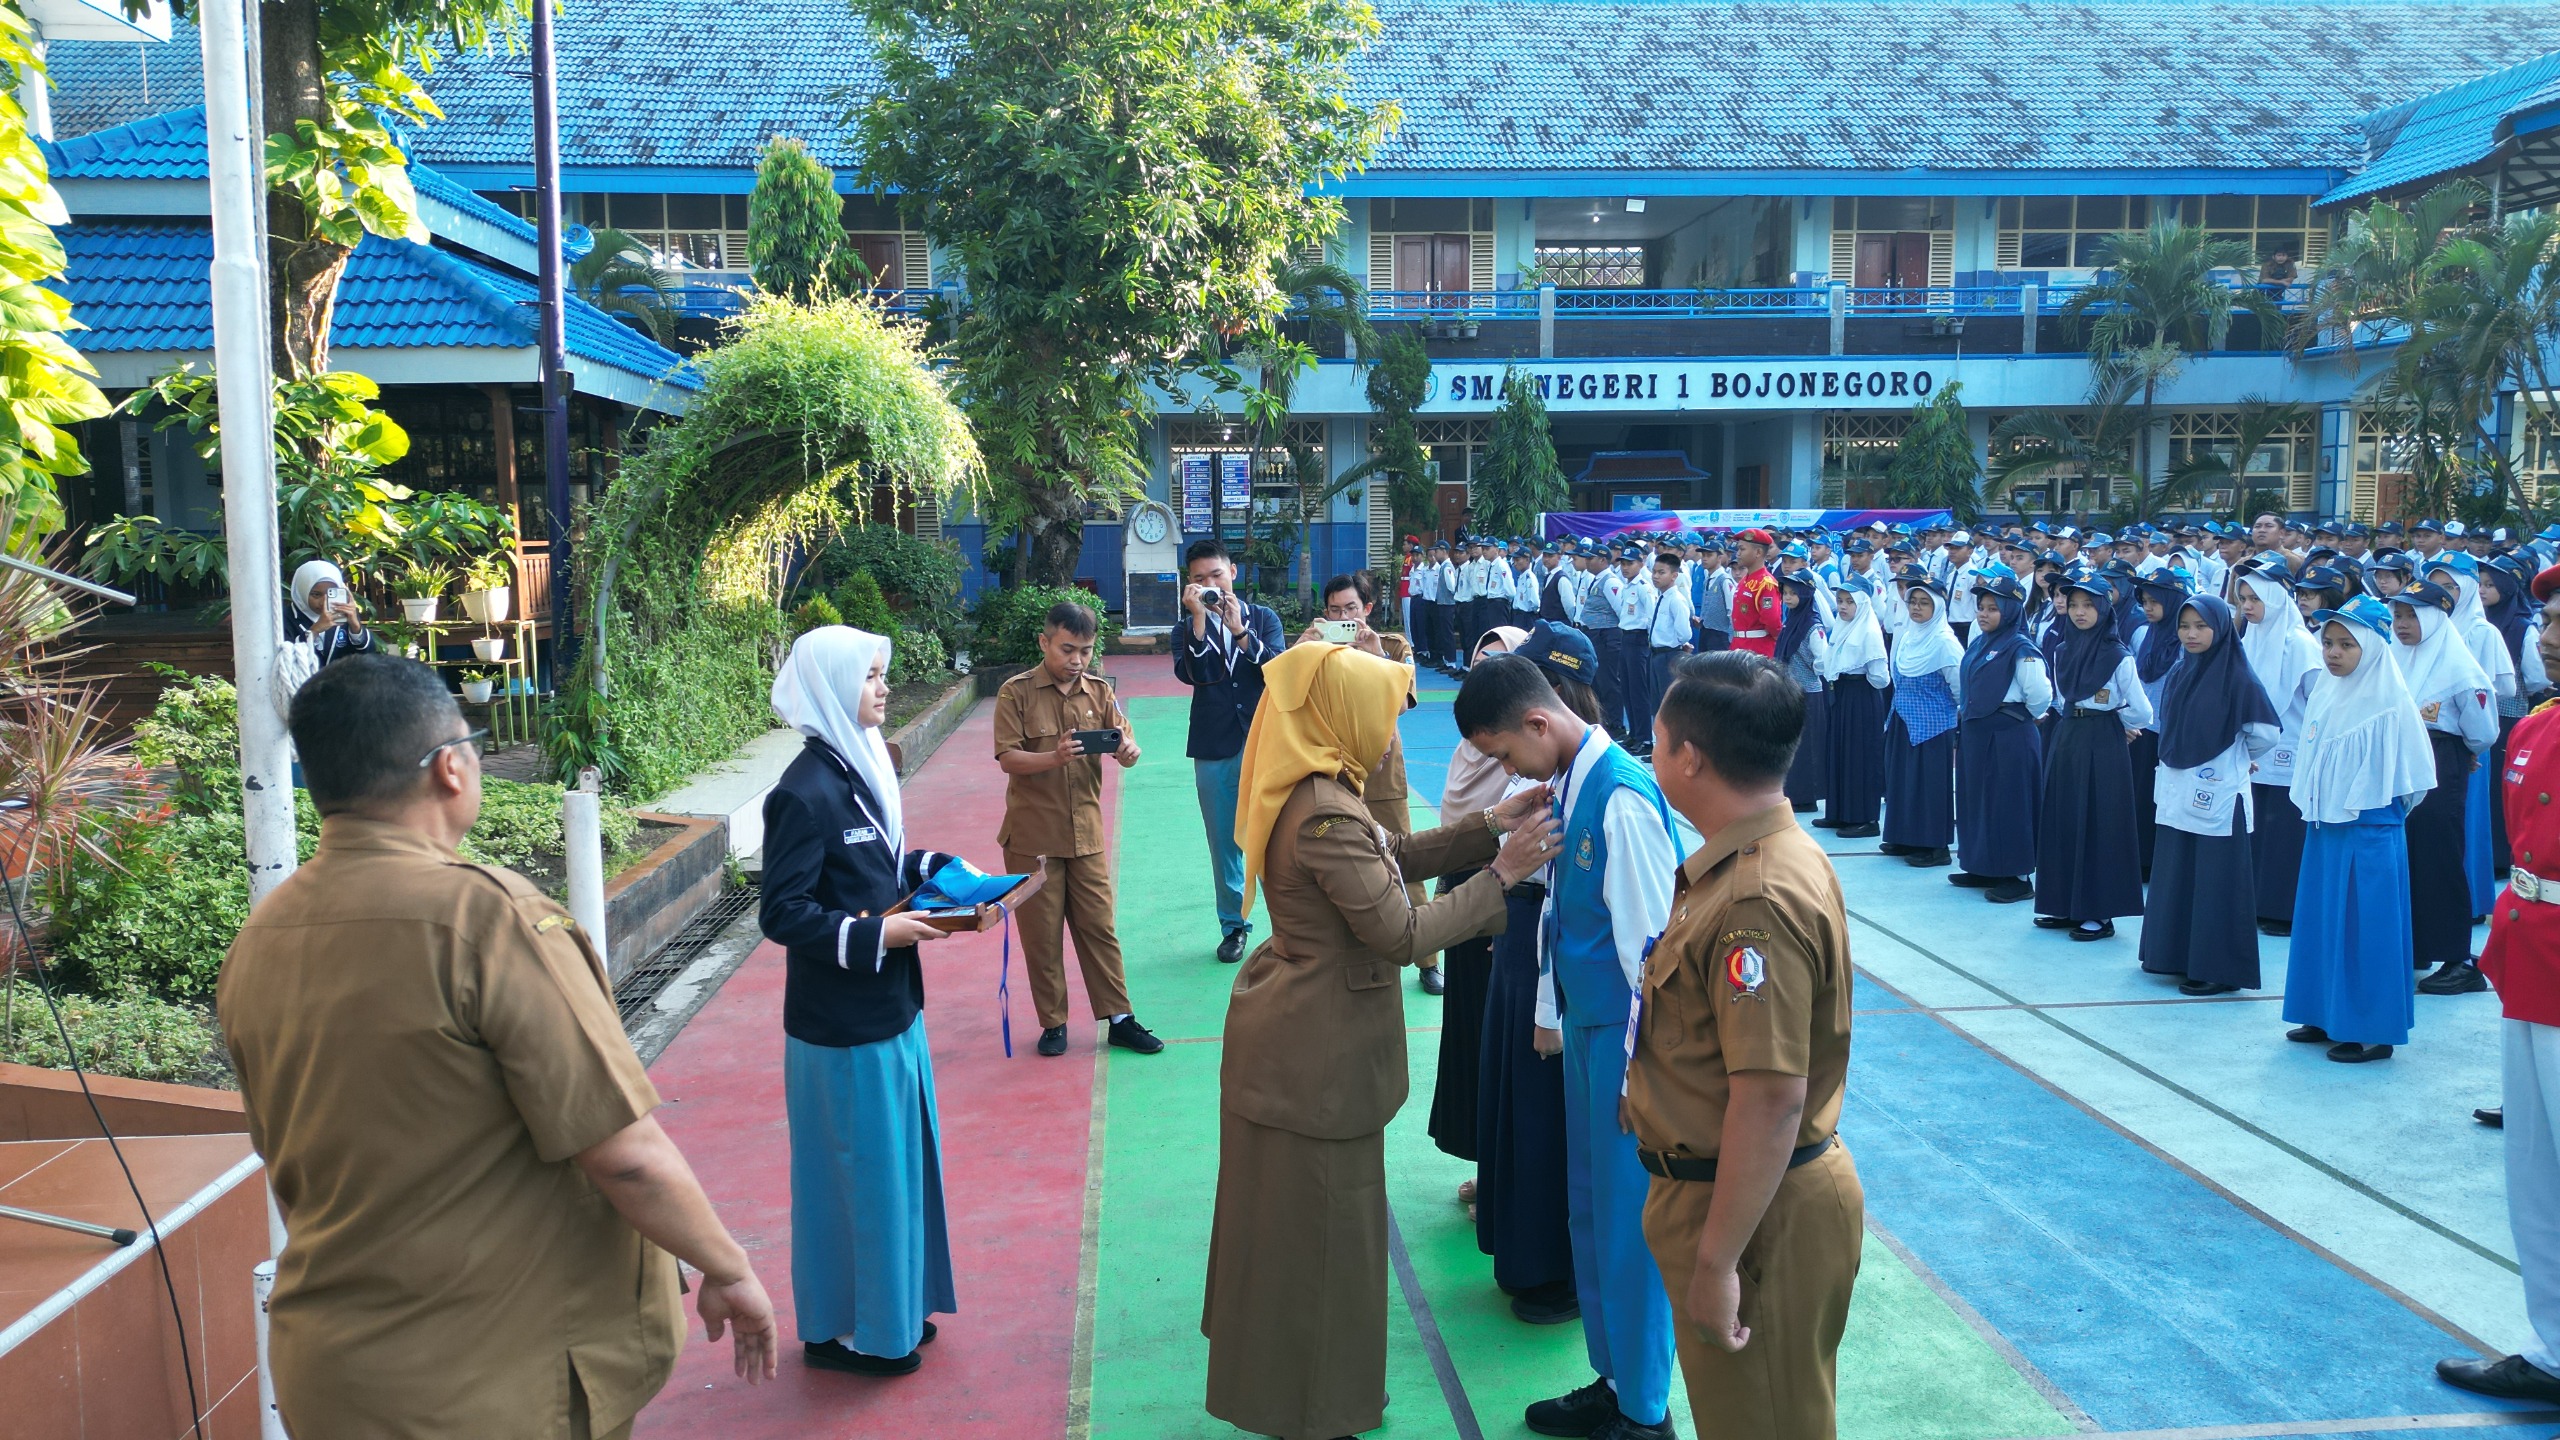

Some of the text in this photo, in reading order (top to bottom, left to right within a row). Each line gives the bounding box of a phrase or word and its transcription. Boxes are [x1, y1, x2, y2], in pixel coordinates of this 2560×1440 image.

[1534, 374, 1658, 400] NEGERI
[1677, 373, 1690, 399] 1
[1710, 370, 1933, 398] BOJONEGORO
